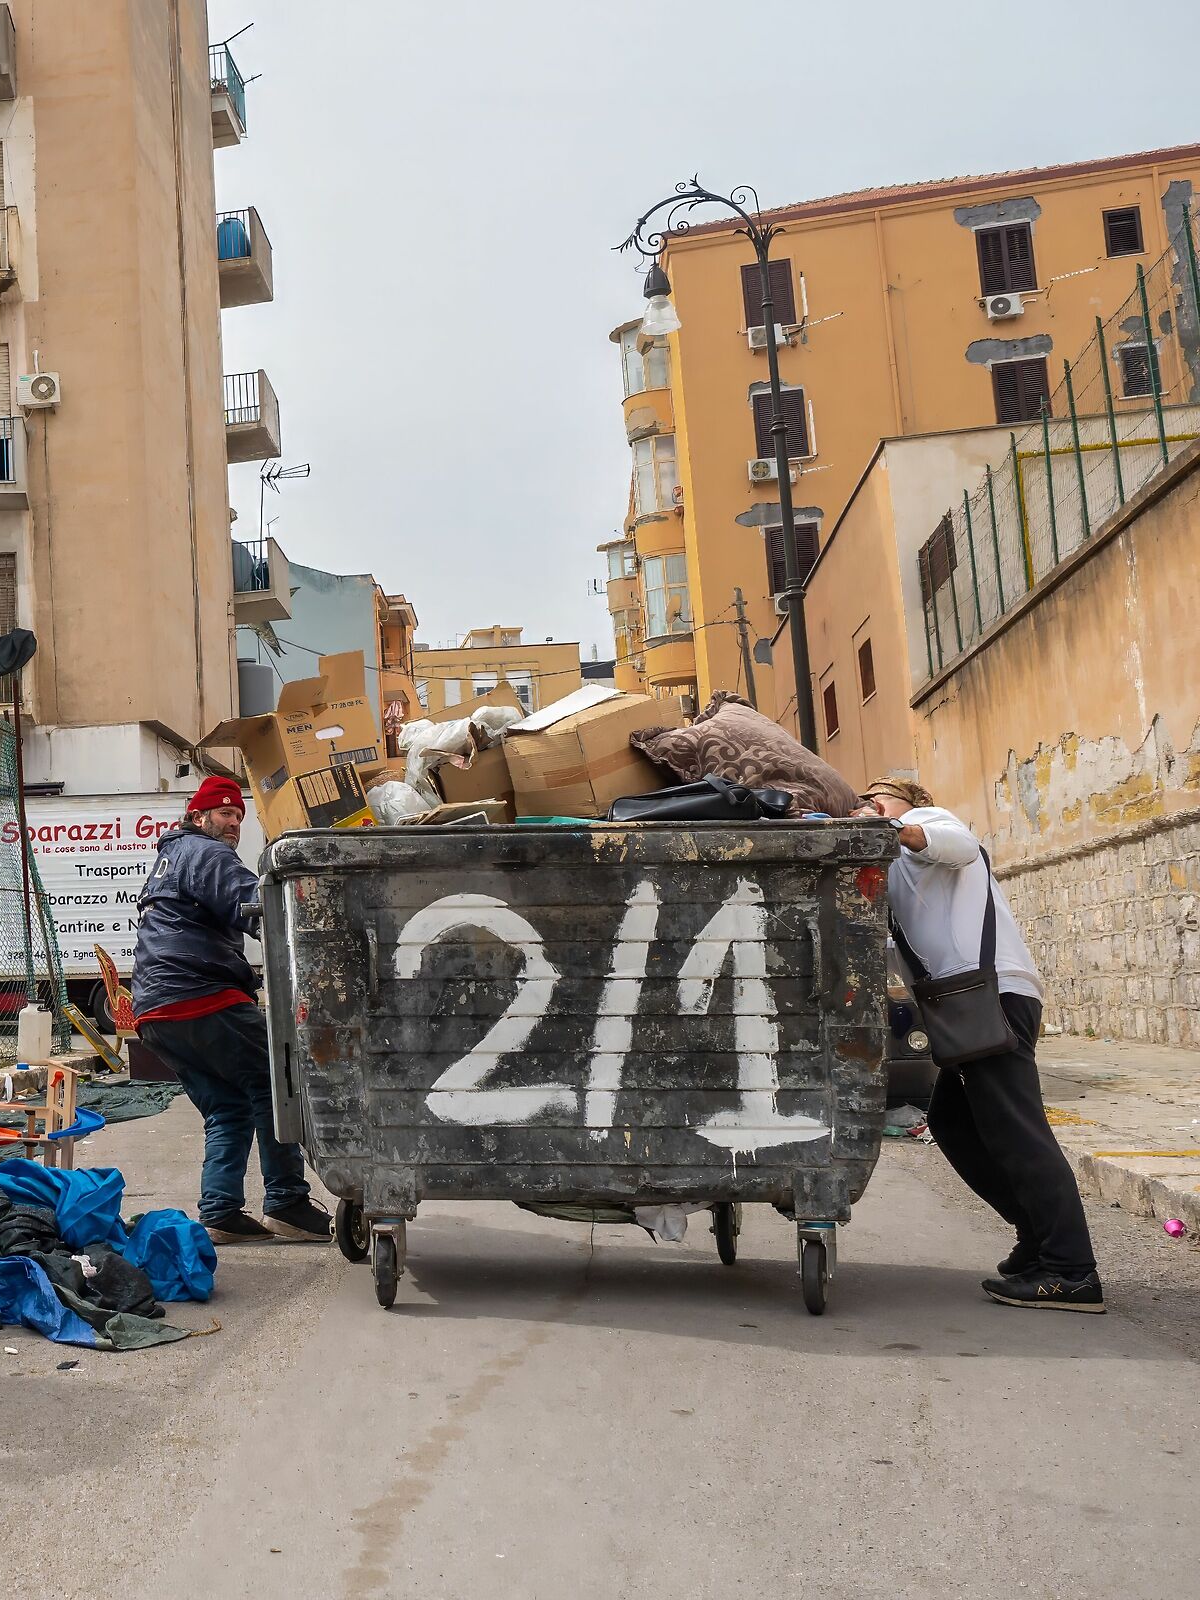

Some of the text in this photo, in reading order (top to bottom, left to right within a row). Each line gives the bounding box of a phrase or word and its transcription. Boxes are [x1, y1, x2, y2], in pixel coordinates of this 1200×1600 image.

[286, 723, 313, 734] MEN
[343, 764, 360, 798] Panasonic
[42, 845, 51, 854] le
[54, 845, 76, 854] cose
[79, 844, 100, 853] sono
[103, 843, 113, 851] di
[116, 842, 147, 851] nostro
[75, 862, 147, 880] Trasporti
[48, 890, 139, 906] barazzo Ma
[112, 922, 120, 931] e
[128, 918, 138, 932] N
